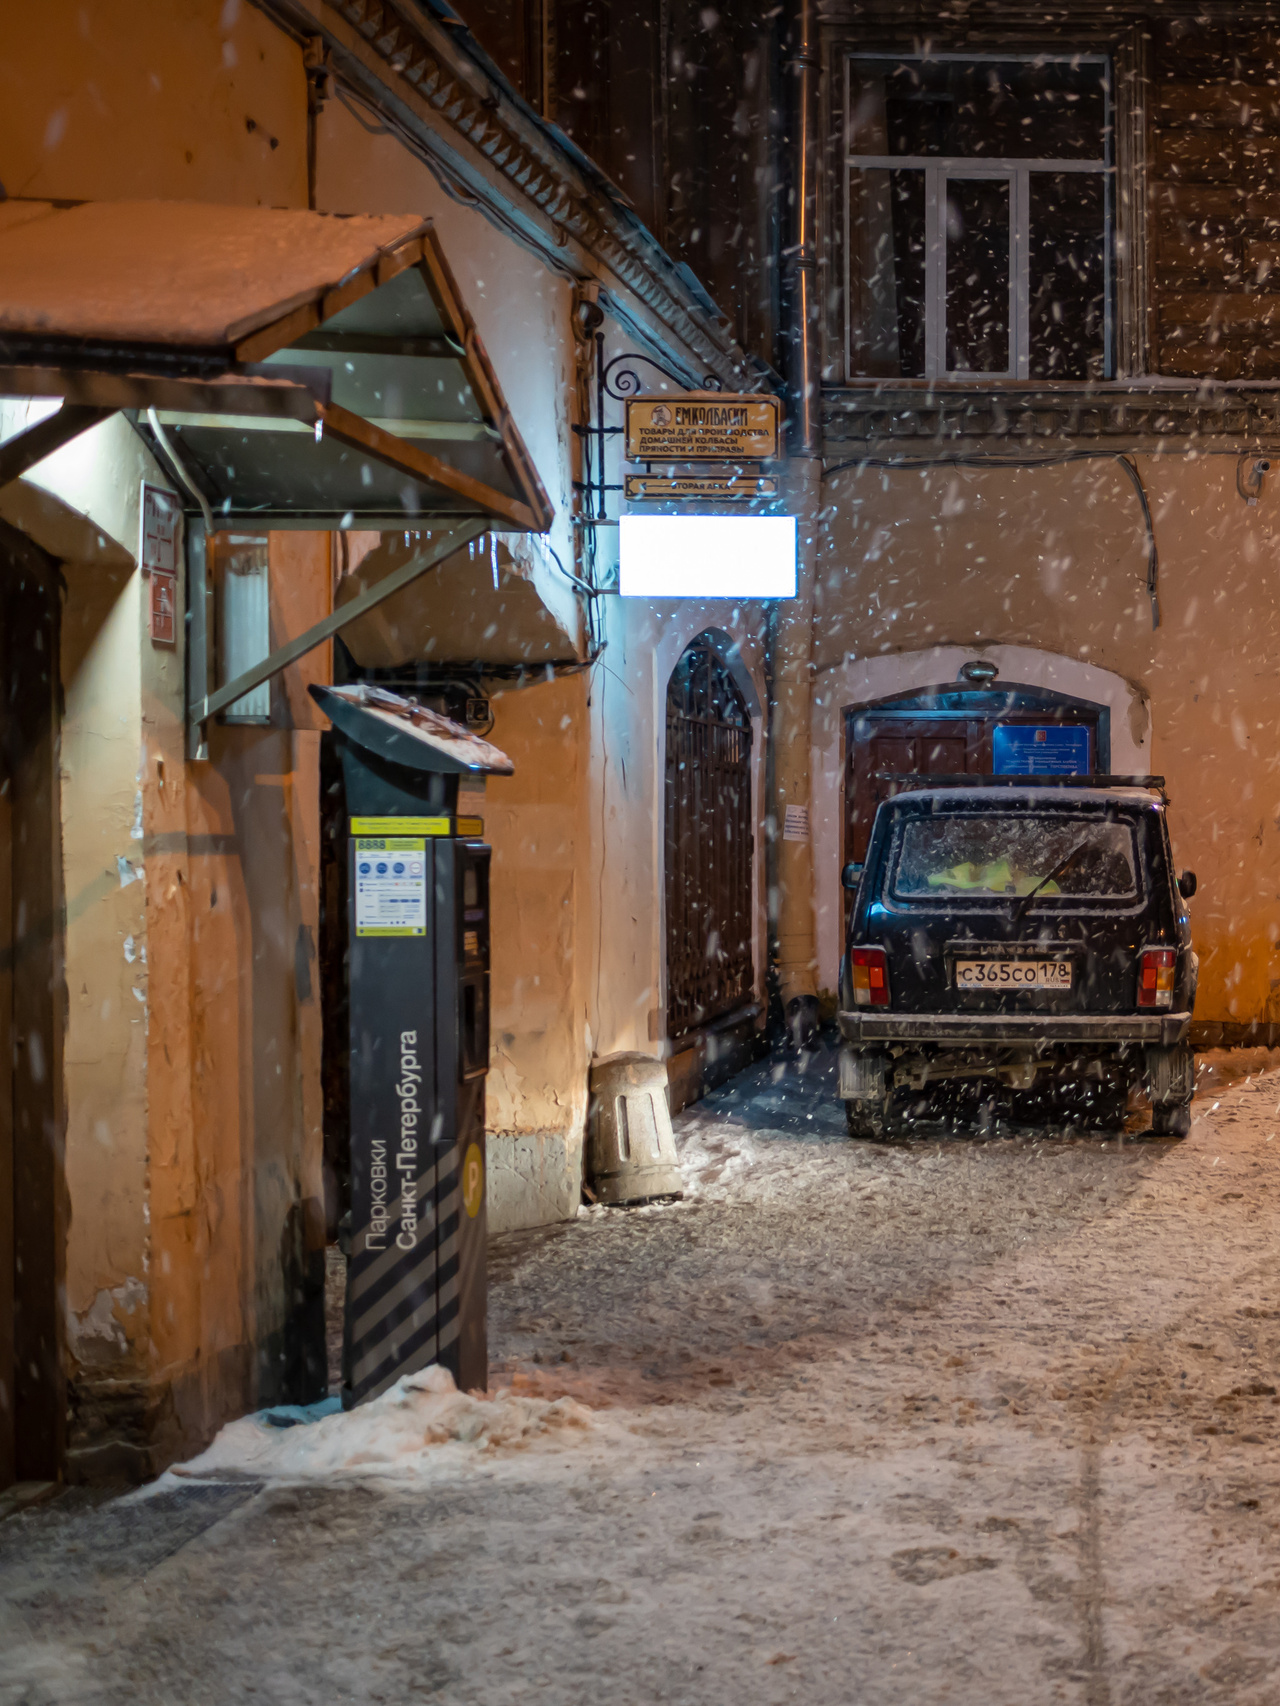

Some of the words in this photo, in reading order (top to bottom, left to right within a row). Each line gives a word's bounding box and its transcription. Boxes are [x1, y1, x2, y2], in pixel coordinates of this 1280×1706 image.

[675, 407, 748, 426] ЕМКОЛБАСКИ
[698, 428, 769, 437] ПРОИЗВОДСТВА
[640, 437, 693, 445] ДОМАШНЕЙ
[1040, 963, 1067, 977] 178
[366, 1140, 391, 1250] Парковки
[396, 1030, 422, 1250] Санкт-Петербурга
